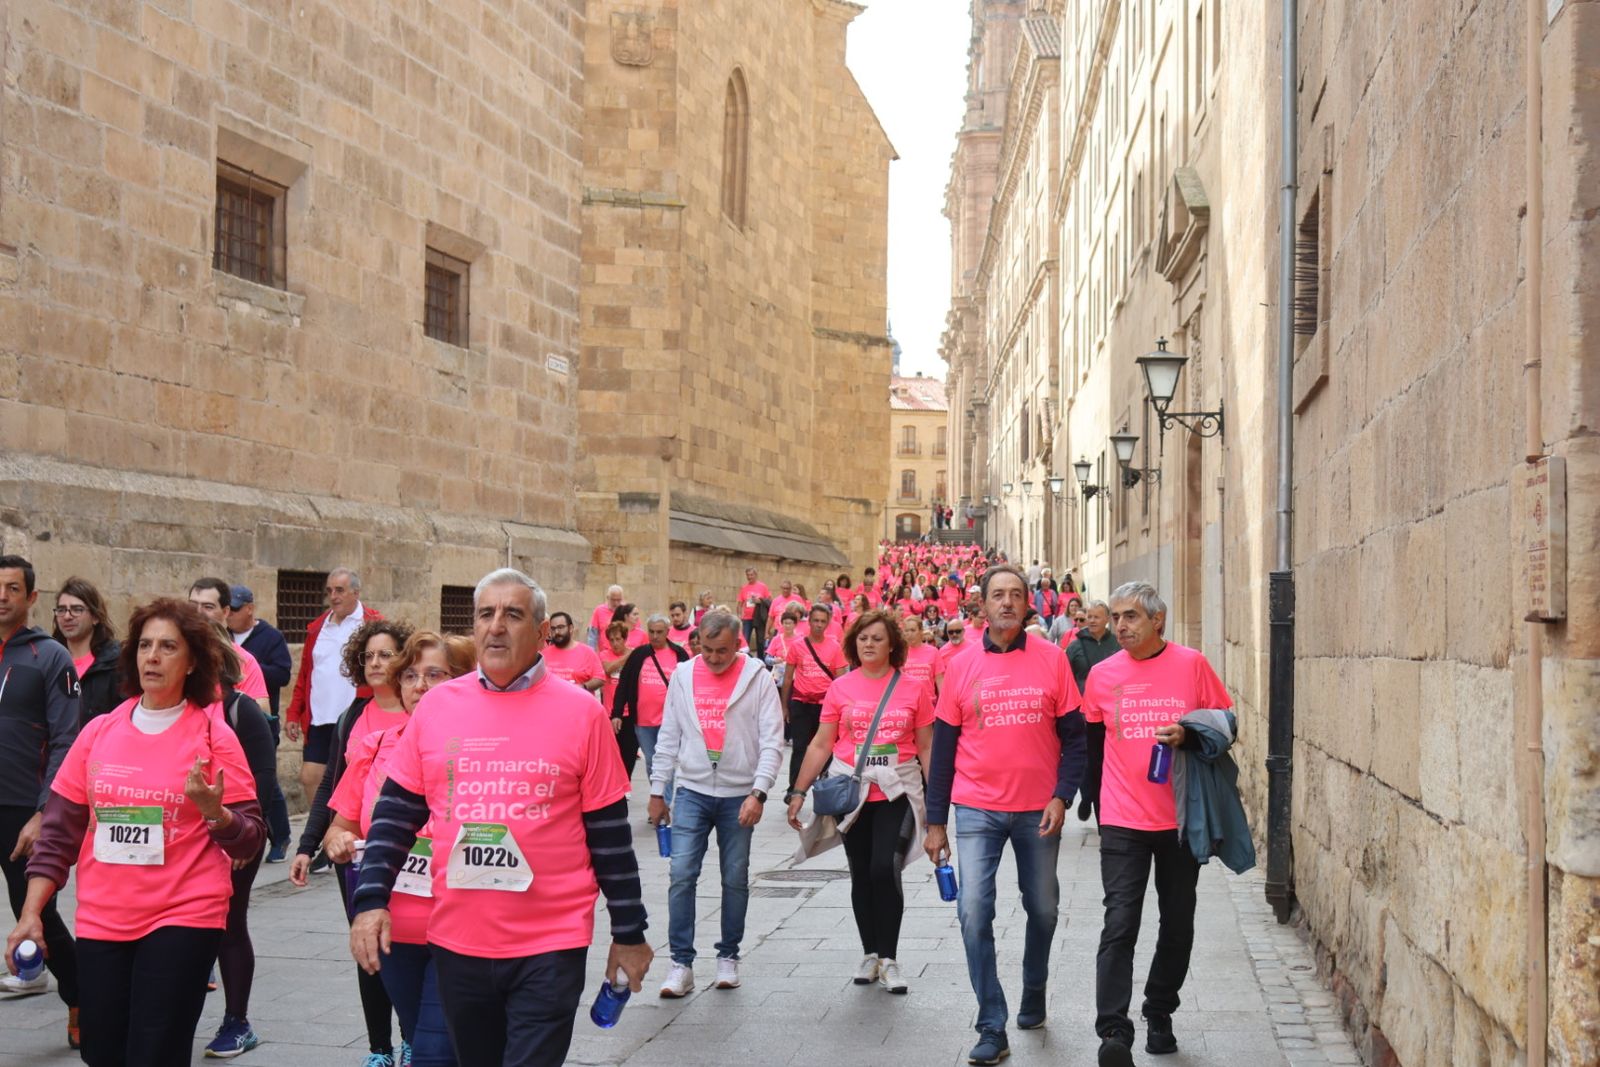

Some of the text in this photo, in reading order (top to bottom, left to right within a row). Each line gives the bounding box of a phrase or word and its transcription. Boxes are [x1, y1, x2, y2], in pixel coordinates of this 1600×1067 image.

[981, 686, 1043, 700] En marcha
[982, 698, 1042, 712] contra el
[1122, 697, 1186, 708] En marcha
[852, 709, 866, 718] En
[985, 712, 1043, 727] cáncer
[1121, 710, 1169, 723] contra
[897, 719, 907, 728] el
[1123, 723, 1156, 739] cán
[458, 757, 560, 776] En marcha
[94, 779, 112, 795] En
[117, 783, 185, 805] marcha
[456, 777, 556, 798] contra el
[455, 796, 551, 820] cáncer
[109, 825, 150, 845] 10221
